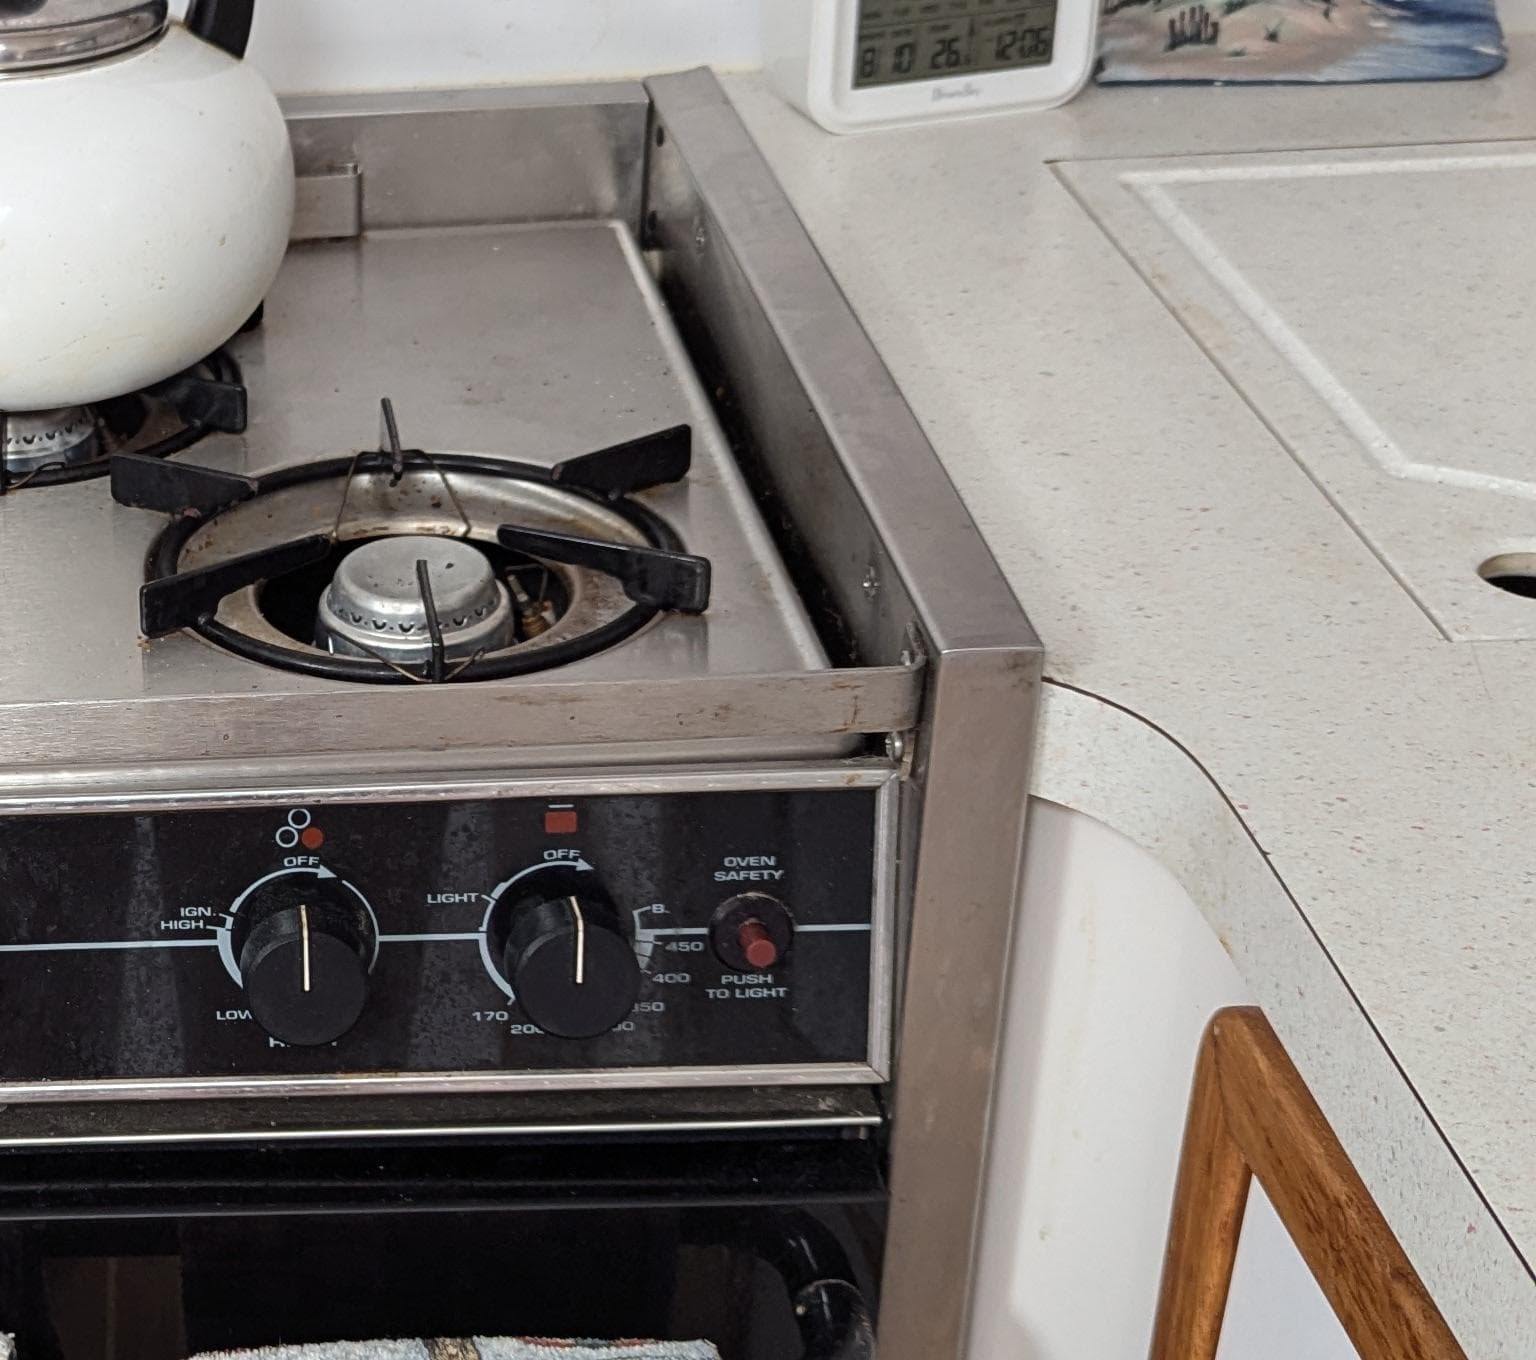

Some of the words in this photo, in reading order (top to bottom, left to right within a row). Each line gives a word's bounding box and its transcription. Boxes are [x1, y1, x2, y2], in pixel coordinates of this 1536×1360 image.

[283, 855, 321, 867] OFF
[543, 849, 581, 861] OFF
[724, 856, 776, 868] OVEN
[714, 869, 785, 881] SAFETY
[426, 892, 480, 904] LIGHT
[180, 906, 216, 919] IGN.
[160, 919, 204, 930] HIGH
[665, 941, 705, 952] 450
[652, 973, 691, 983] 400
[721, 974, 774, 985] PUSH
[706, 989, 730, 999] TO
[735, 987, 788, 999] LIGHT
[472, 1011, 509, 1021] 170
